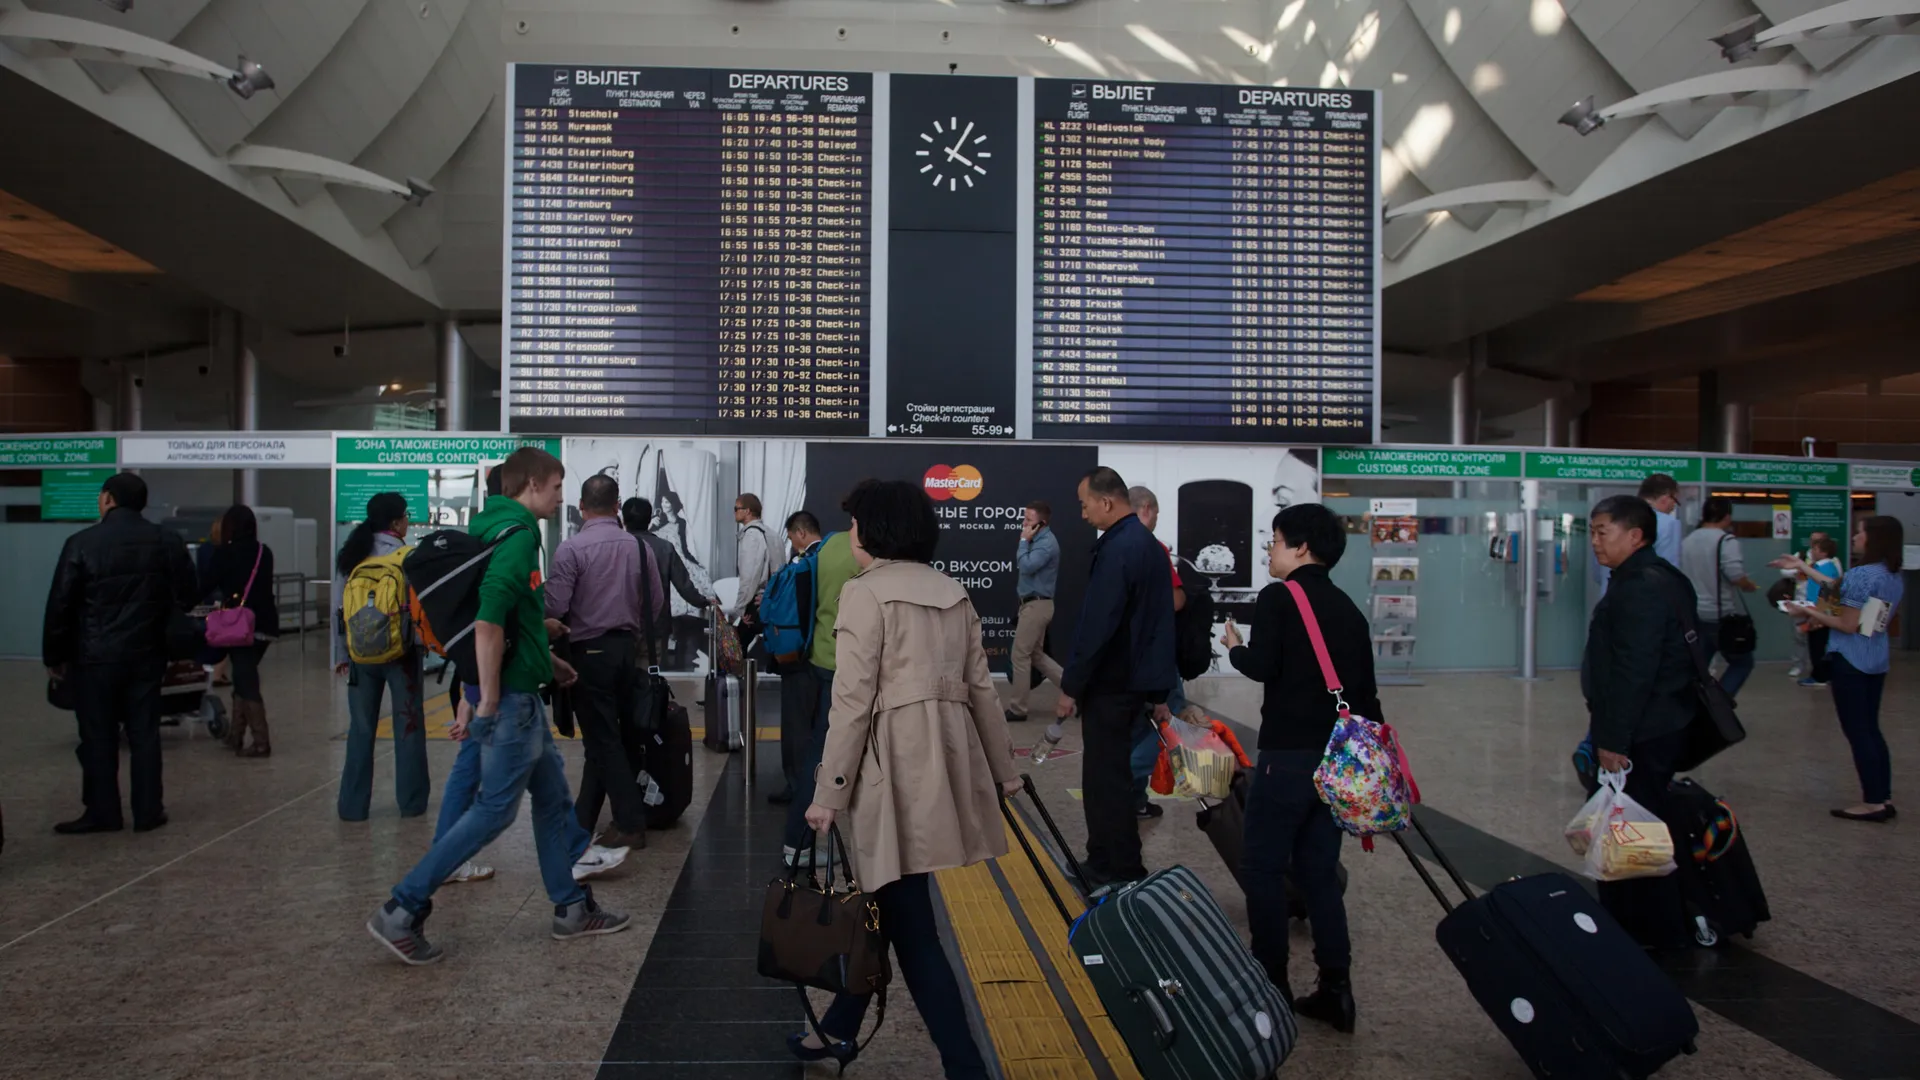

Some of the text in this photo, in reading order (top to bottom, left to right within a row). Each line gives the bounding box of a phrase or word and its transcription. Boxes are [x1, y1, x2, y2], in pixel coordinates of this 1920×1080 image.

[575, 70, 641, 86] ВЫЛЕТ
[729, 73, 849, 91] DEPARTURES
[551, 87, 570, 97] РЕЙС
[684, 91, 706, 100] ЧЕРЕЗ
[1092, 84, 1156, 101] ВЫЛЕТ
[549, 97, 572, 106] FLIGHT
[619, 98, 661, 108] DESTINATION
[689, 100, 700, 108] VIA
[1238, 90, 1352, 108] DEPARTURES
[827, 103, 858, 113] REMARKS
[568, 110, 618, 119] Stockholm
[818, 115, 856, 124] Delayed
[1067, 110, 1090, 119] FLIGHT
[568, 123, 613, 132] Murmansk
[818, 128, 856, 137] Delayed
[568, 136, 613, 144] Murmansk
[818, 140, 856, 150] Delayed
[568, 148, 633, 158] Ekaterinburg
[818, 153, 861, 161] Check-in
[568, 161, 633, 171] Ekaterinburg
[818, 166, 861, 174] Check-in
[1086, 161, 1113, 169] Sochi
[567, 174, 633, 184] Ekaterinburg
[818, 179, 861, 187] Check-in
[1086, 173, 1113, 182] Sochi
[567, 187, 633, 197] Ekaterinburg
[817, 191, 861, 200] Check-in
[1086, 186, 1113, 194] Sochi
[566, 252, 610, 260] Helsinki
[566, 265, 610, 273] Helsinki
[566, 278, 615, 286] Stavropol
[566, 290, 615, 299] Stavropol
[565, 316, 615, 325] Krasnodar
[565, 329, 615, 338] Krasnodar
[565, 342, 615, 351] Krasnodar
[1085, 389, 1112, 397] Sochi
[564, 395, 625, 403] Vladivostok
[906, 403, 995, 414] Стойки регистрации
[1085, 402, 1112, 410] Sochi
[564, 408, 625, 417] Vladivostok
[912, 413, 989, 423] Check-in counters
[1085, 414, 1112, 423] Sochi
[971, 425, 1003, 435] 55-99
[53, 440, 105, 450] КОНТРОЛЯ
[167, 441, 286, 450] ТОЛЬКО ДЛЯ ПЕРСОНАЛА
[355, 440, 386, 450] ЗОНА
[390, 440, 480, 450] ТАМОЖЕННОГО
[17, 453, 62, 463] CONTROL
[64, 452, 89, 463] ZONE
[167, 453, 286, 461] AUTHORIZED PERSONNEL ONLY
[378, 452, 433, 463] CUSTOMS
[1336, 450, 1506, 463] ЗОНА ТАМОЖЕННОГО КОНТРОЛЯ
[1539, 455, 1689, 468] ЗОНА ТАМОЖЕННОГО КОНТРОЛЯ
[1357, 463, 1491, 475] CUSTOMS CONTROL ZONE
[1557, 467, 1602, 478] CUSTOMS
[1604, 468, 1647, 479] CONTROL
[924, 477, 981, 489] MasterCard
[1731, 472, 1768, 482] CUSTOMS
[1807, 474, 1827, 484] ZONE
[950, 561, 1012, 573] ВКУСОМ
[981, 616, 1004, 625] ваш
